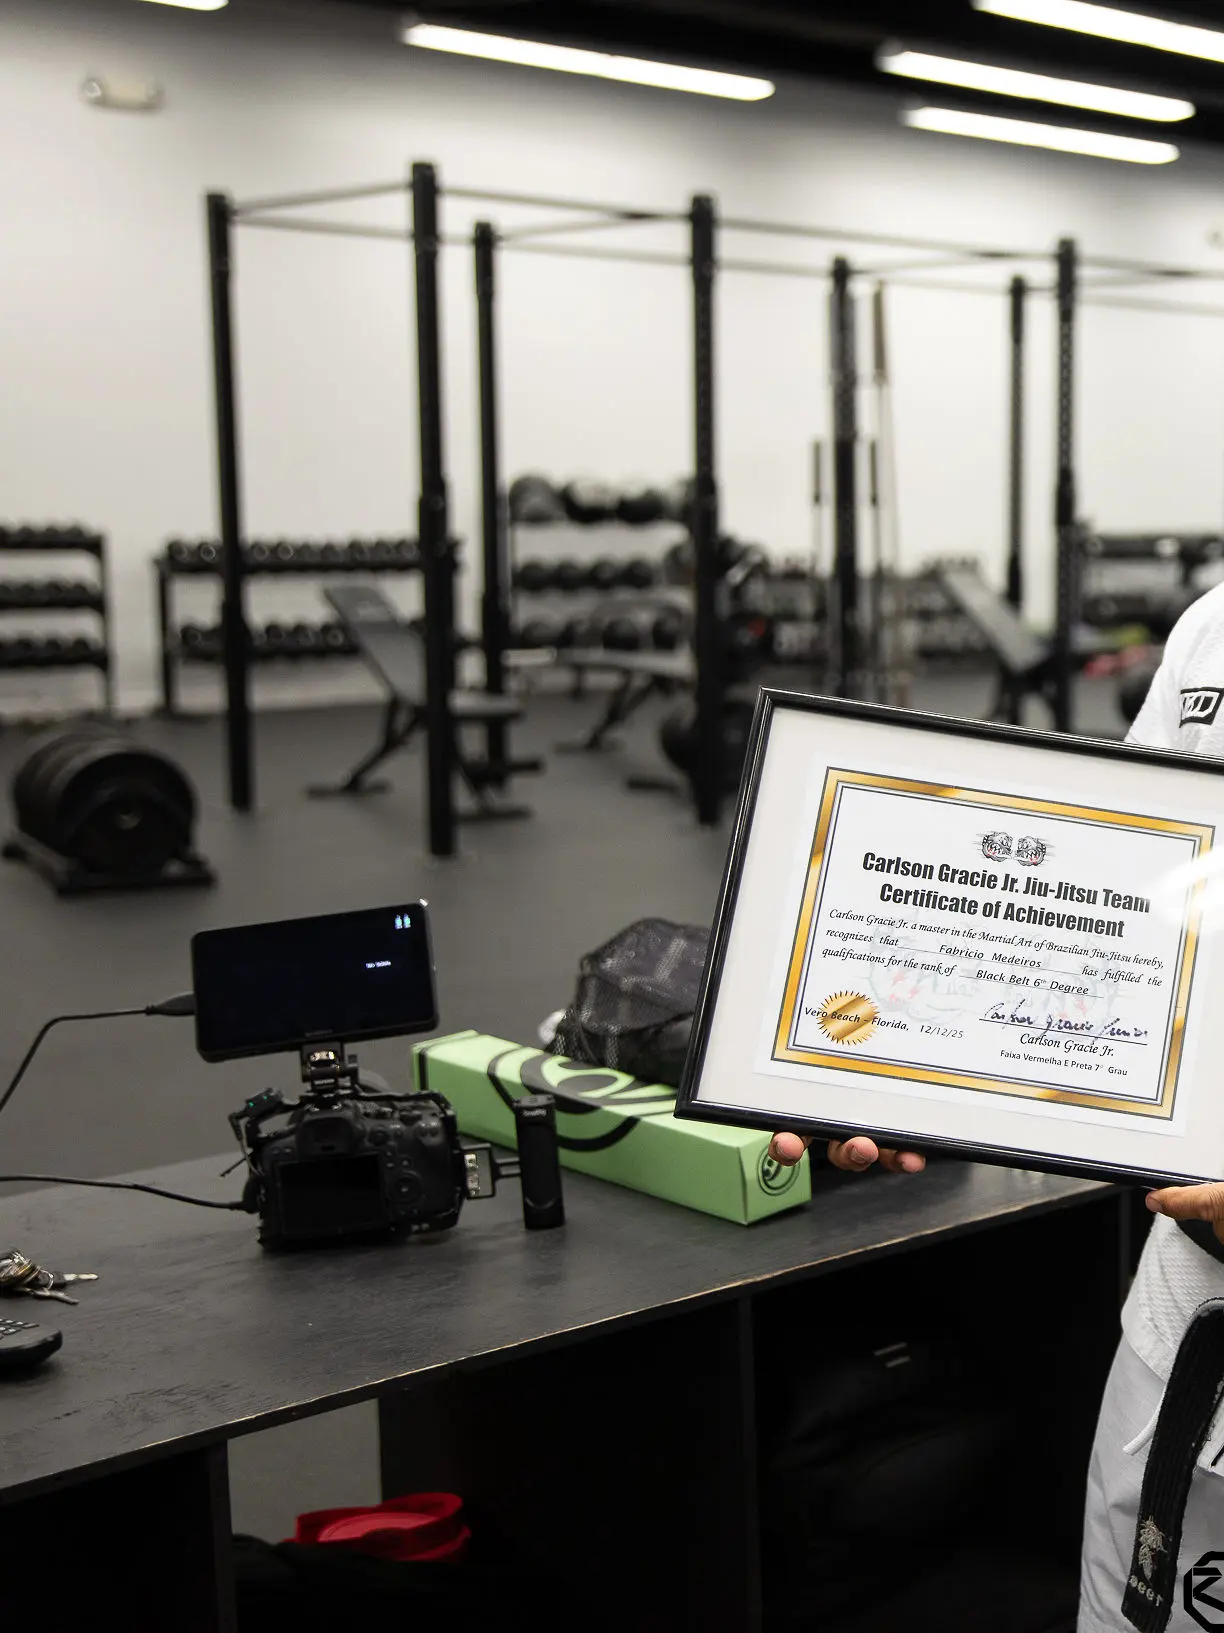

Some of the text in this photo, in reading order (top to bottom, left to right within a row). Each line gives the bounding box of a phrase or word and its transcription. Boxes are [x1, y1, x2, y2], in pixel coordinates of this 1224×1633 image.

[862, 852, 1151, 914] Carlson Gracie Jr. Jiu-Jitsu Team
[879, 883, 1125, 938] Certificate of Achievement
[826, 928, 1163, 987] recognizes that Fabricio Medeiros has fulfilled the
[829, 908, 865, 922] Carlson
[866, 914, 896, 928] Gracie
[896, 919, 908, 930] Jr.
[918, 924, 950, 936] master
[950, 926, 961, 937] in
[962, 928, 976, 940] the
[977, 931, 1016, 945] Martial
[1014, 936, 1033, 948] Art
[1033, 939, 1046, 951] of
[1046, 941, 1090, 957] Brazilian
[1088, 948, 1132, 963] Jiu-Jitsu
[1132, 953, 1164, 969] hereby,
[822, 947, 885, 964] qualifications
[885, 955, 902, 968] for
[903, 958, 919, 970] the
[920, 962, 943, 975] rank
[943, 964, 958, 978] of
[977, 969, 1006, 983] Black
[1008, 974, 1030, 986] Belt
[1049, 980, 1089, 995] Degree
[804, 1006, 828, 1019] Vero
[830, 1011, 861, 1023] Beach
[871, 1017, 910, 1032] Florida,
[919, 1024, 964, 1039] 12/12/25
[1020, 1032, 1115, 1057] Carlson Gracie Jr.
[1000, 1050, 1021, 1060] Faixa
[1023, 1053, 1062, 1066] Vermelha
[1064, 1059, 1069, 1067] E
[1071, 1060, 1093, 1071] Preta
[1108, 1066, 1128, 1076] Grau
